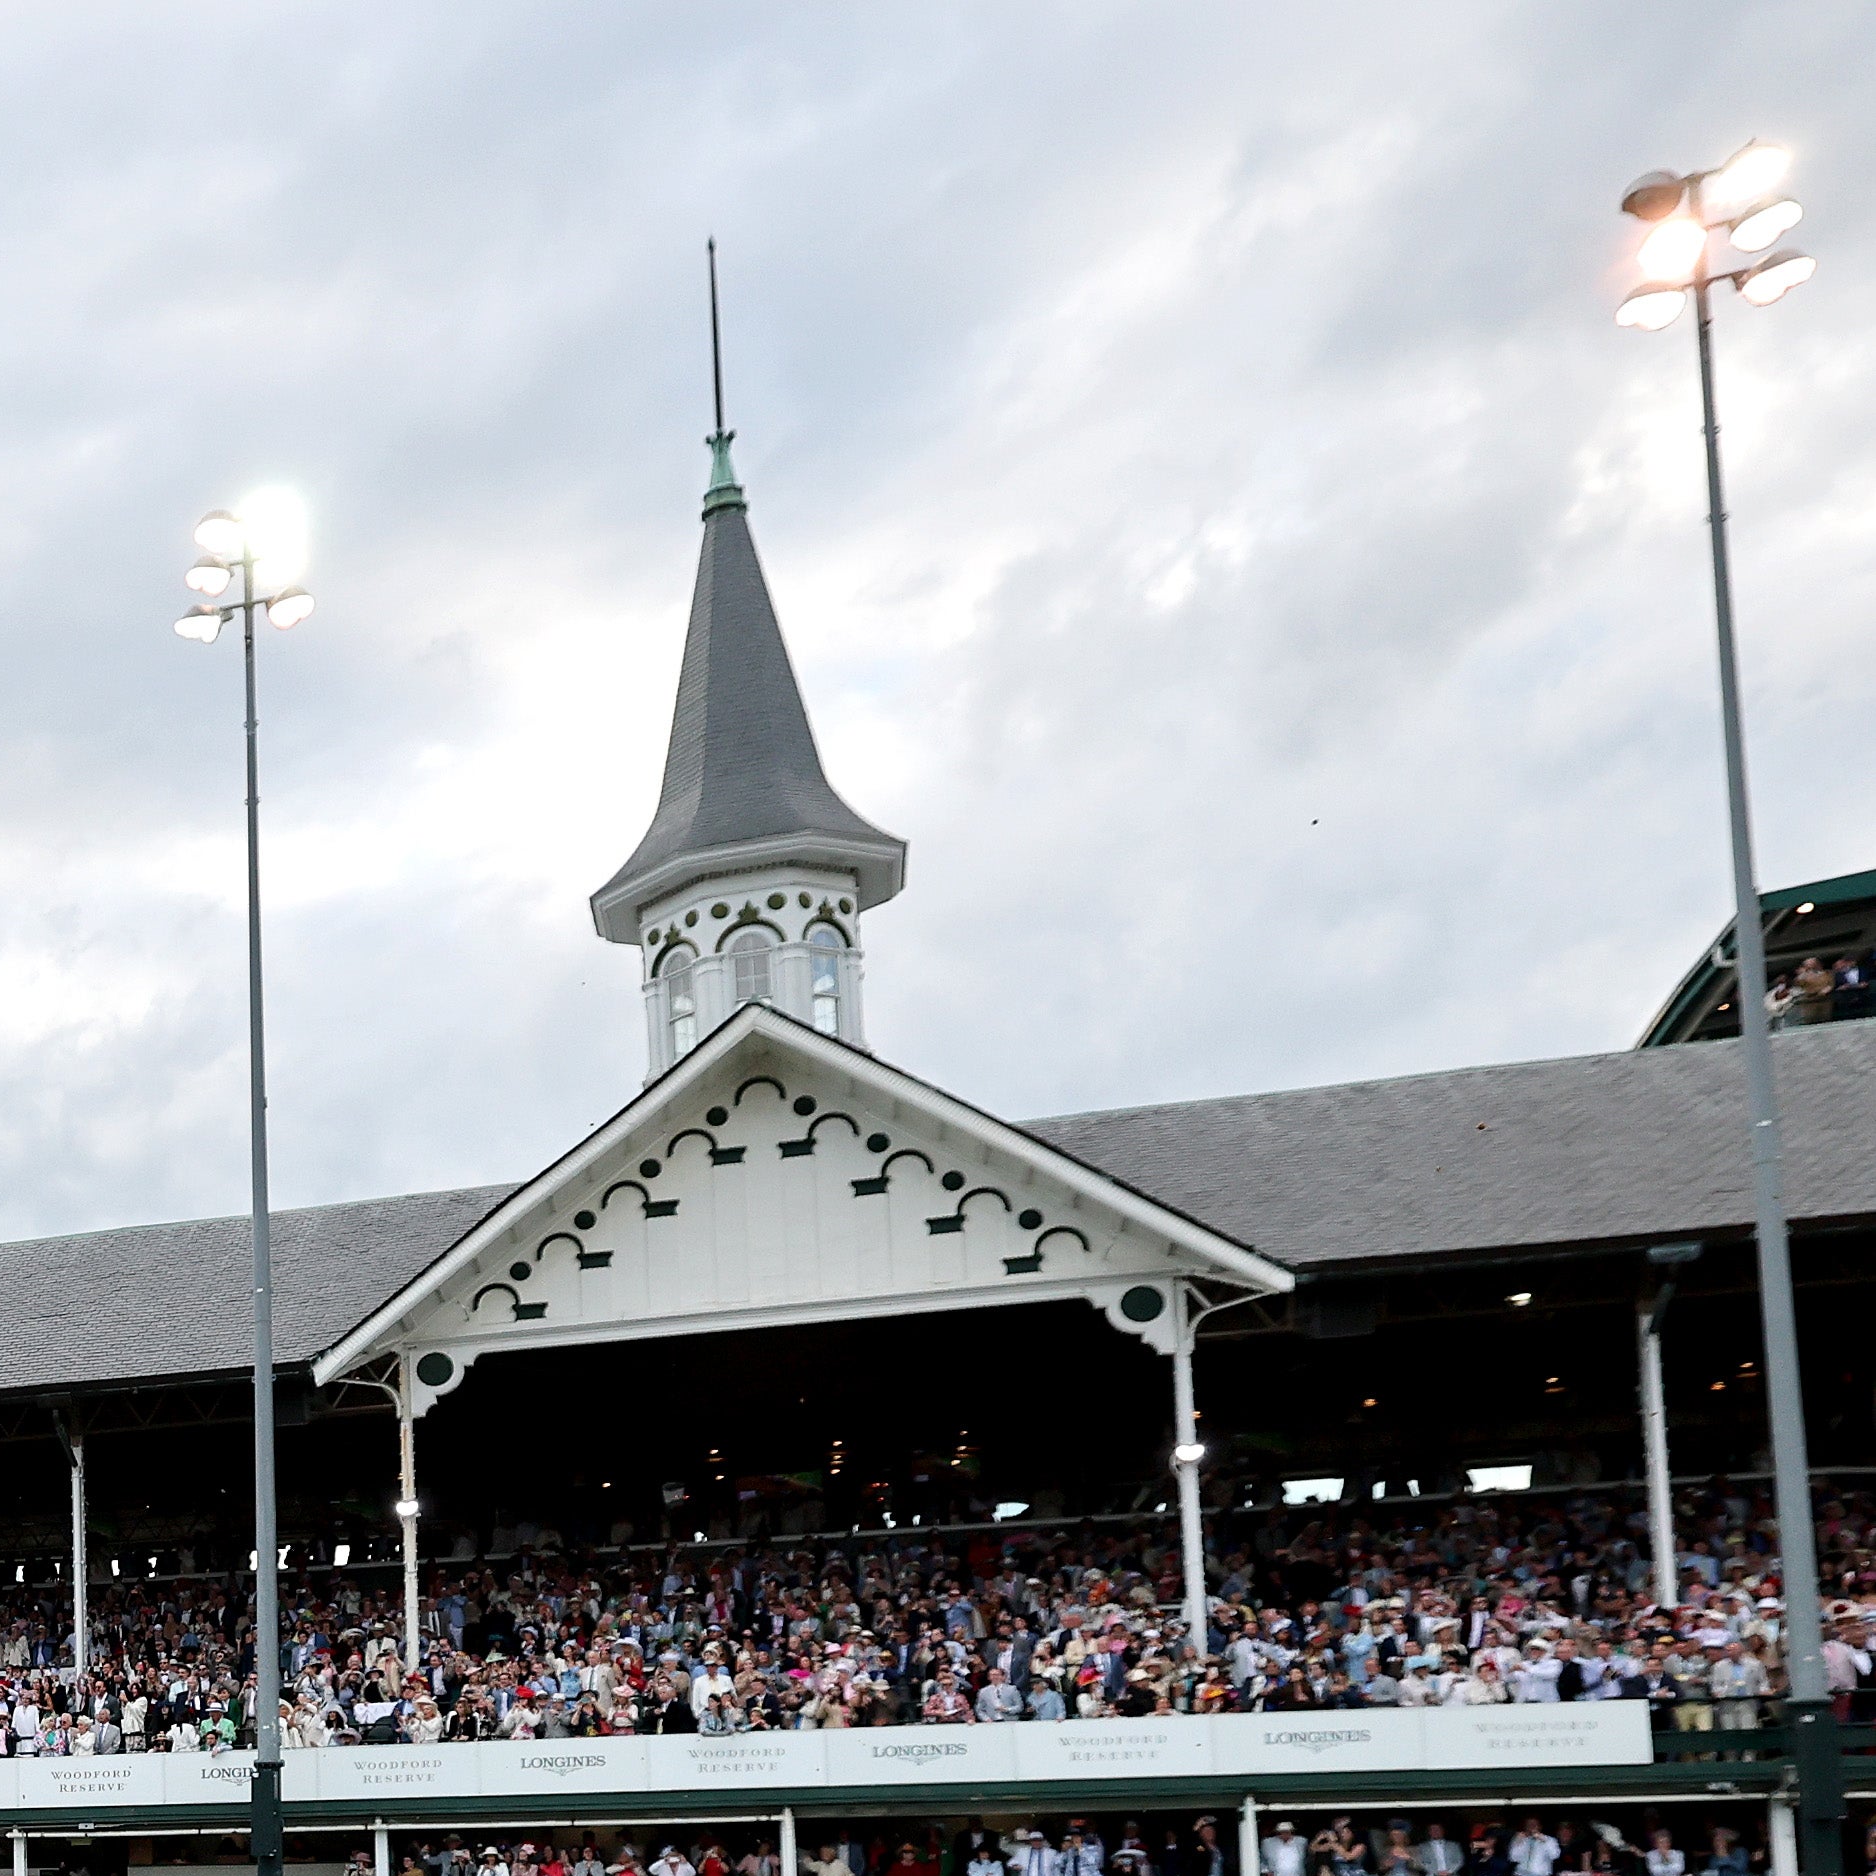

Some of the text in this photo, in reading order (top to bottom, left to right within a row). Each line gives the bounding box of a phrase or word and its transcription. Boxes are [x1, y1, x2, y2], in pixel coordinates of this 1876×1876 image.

[1262, 1729, 1372, 1745] LONGINES
[687, 1748, 786, 1759] WOODFORD
[872, 1743, 968, 1759] LONGINES
[353, 1759, 443, 1771] WOODFORD
[520, 1755, 607, 1769] LONGINES
[697, 1762, 778, 1774] RESERVE
[50, 1769, 132, 1781] WOODFORD
[201, 1767, 253, 1779] LONGI
[363, 1773, 436, 1784] RESERVE
[59, 1783, 125, 1793] RESERVE
